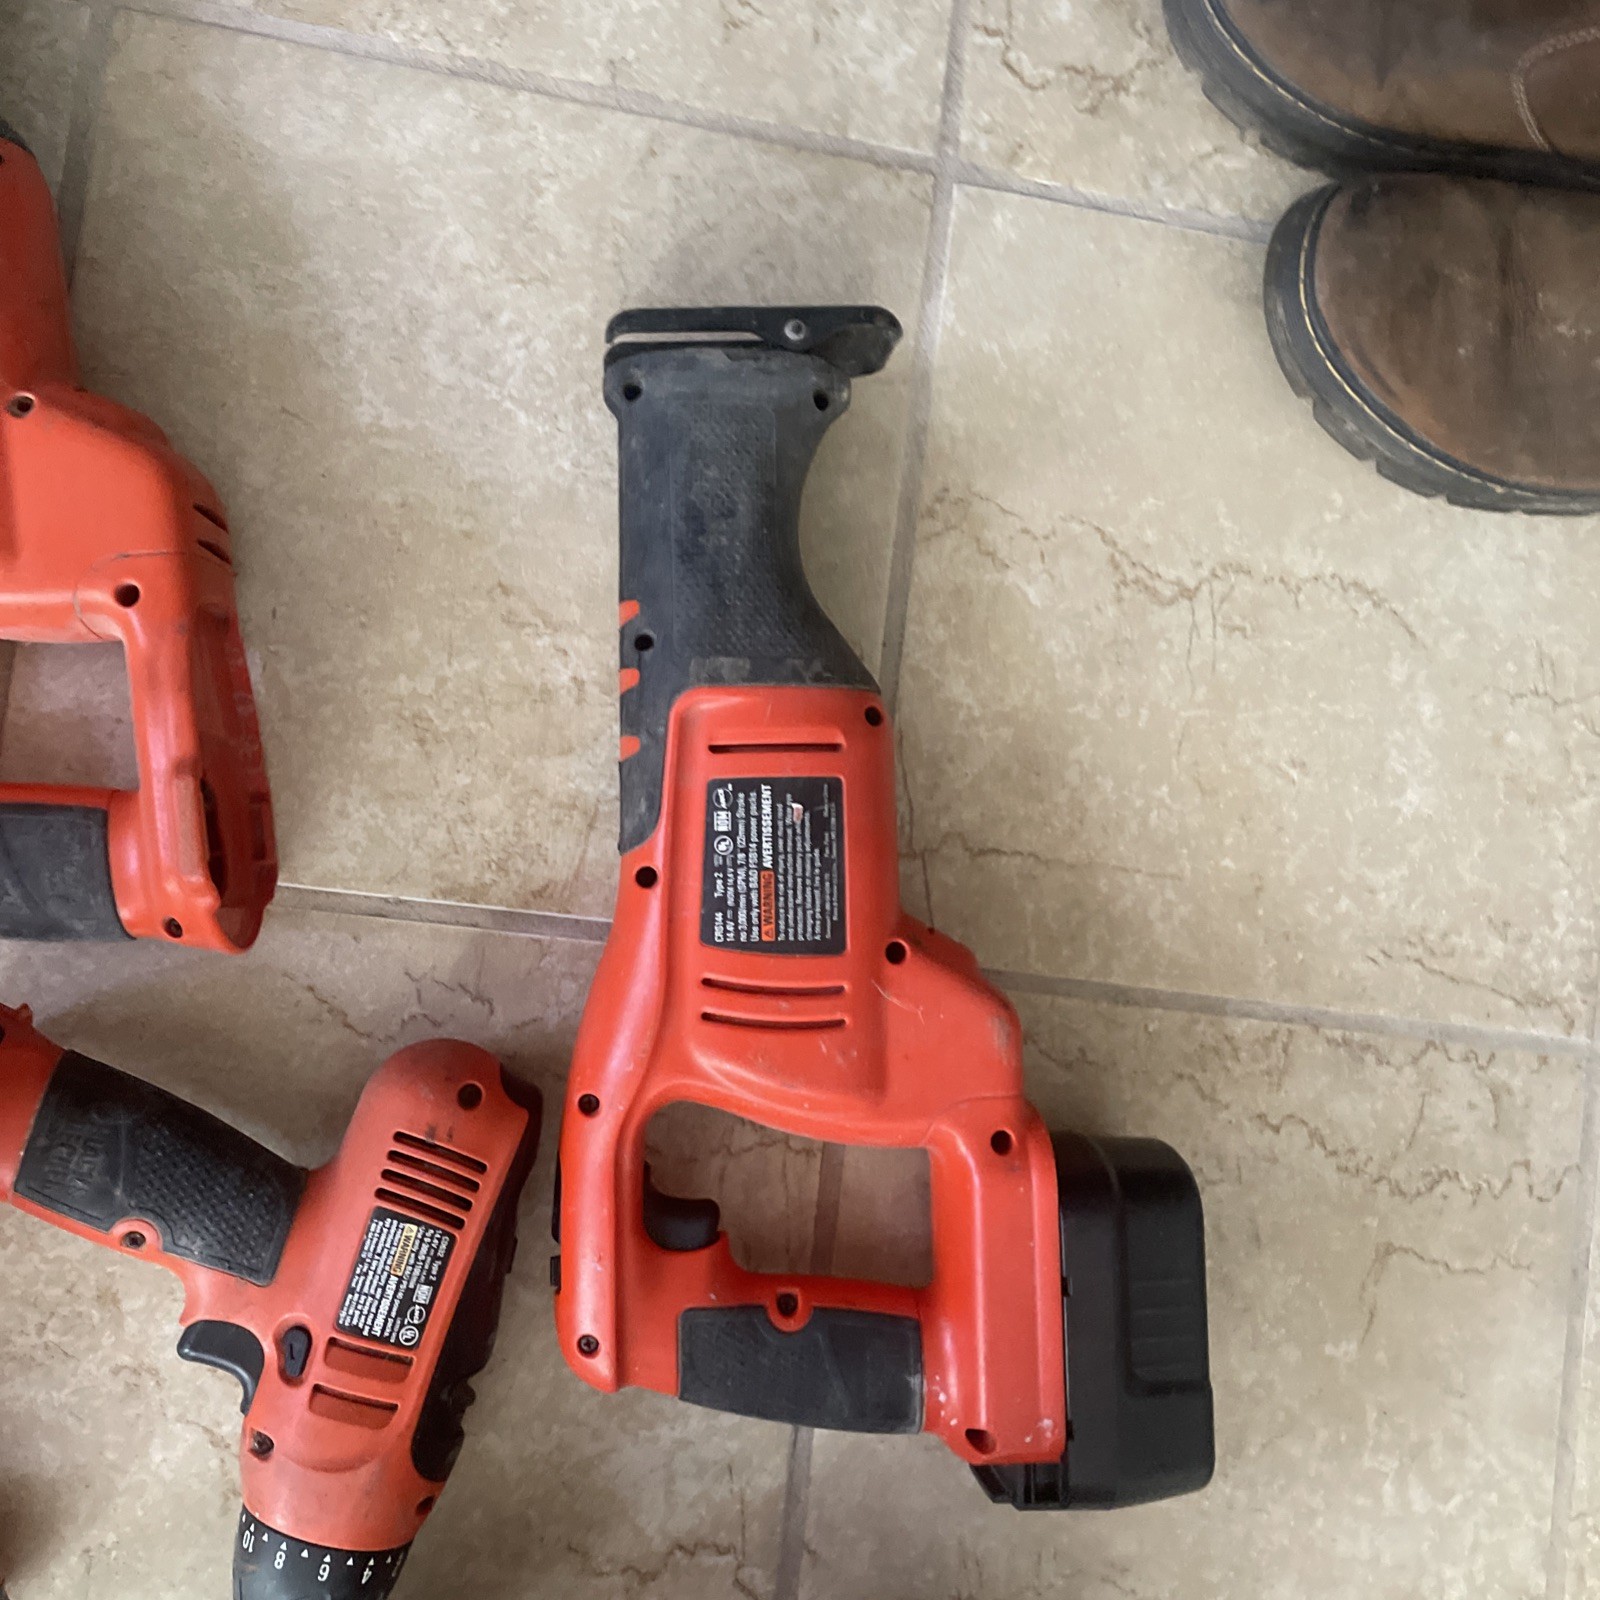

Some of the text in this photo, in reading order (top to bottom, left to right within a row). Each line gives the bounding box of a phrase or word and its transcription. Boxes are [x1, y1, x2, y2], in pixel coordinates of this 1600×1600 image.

[750, 817, 759, 842] power
[761, 784, 773, 869] AVERTISSEMENT
[714, 879, 725, 898] Type
[763, 873, 773, 925] WARNING
[751, 908, 760, 924] only
[751, 926, 759, 942] Use
[392, 1233, 412, 1273] WARNING
[410, 1238, 421, 1252] only
[407, 1252, 416, 1265] with
[429, 1258, 442, 1275] Type
[370, 1274, 398, 1337] AVERTISSEMENT
[388, 1298, 400, 1318] power
[242, 1530, 256, 1553] 10
[273, 1551, 287, 1570] 8
[317, 1563, 331, 1582] 6
[361, 1566, 373, 1585] 4
